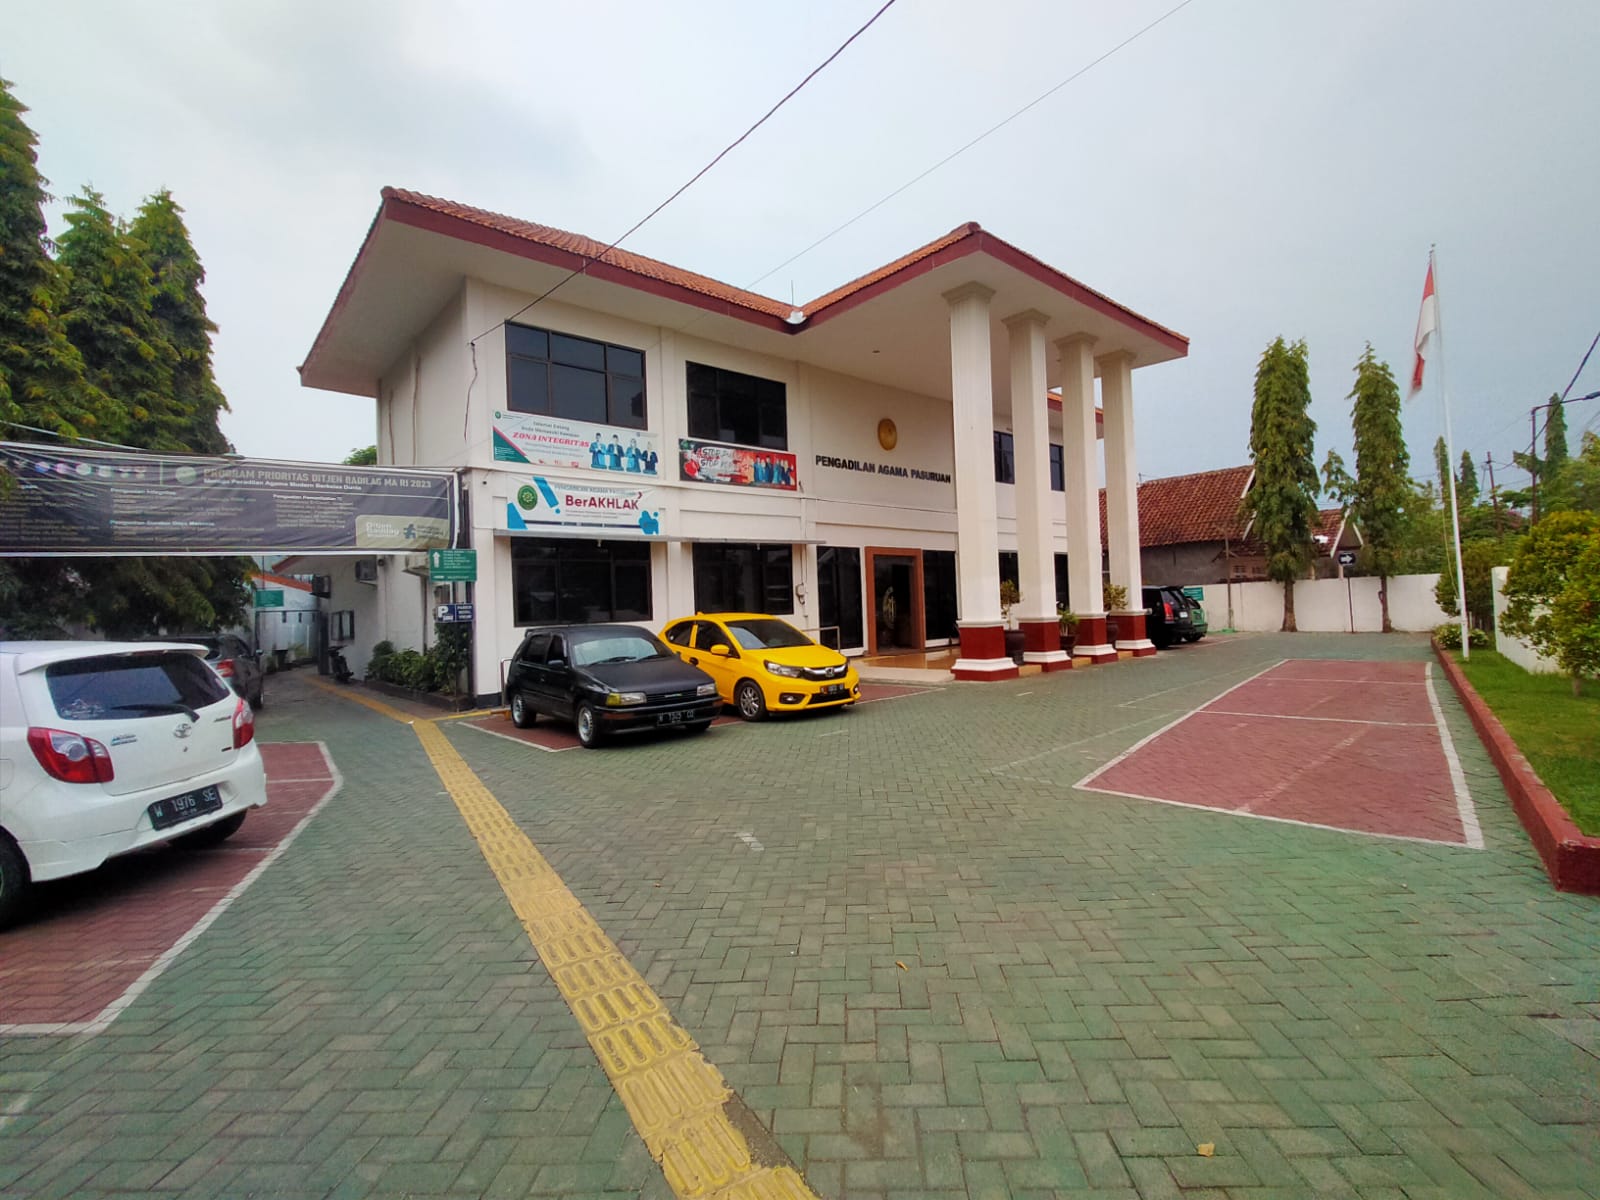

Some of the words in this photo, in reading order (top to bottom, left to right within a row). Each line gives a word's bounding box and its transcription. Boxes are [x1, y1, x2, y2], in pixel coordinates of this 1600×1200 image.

[512, 432, 536, 441] ZONA
[538, 434, 590, 448] INTEGRITAS
[203, 468, 255, 479] PROGRAM
[258, 470, 309, 481] PRIORITAS
[311, 473, 343, 483] DITJEN
[345, 475, 382, 486] BADILAG
[384, 478, 398, 487] MA
[400, 479, 409, 488] RI
[410, 480, 432, 488] 2023
[815, 454, 876, 474] PENGADILAN
[878, 464, 909, 478] AGAMA
[910, 469, 951, 484] PASURUAN
[565, 494, 639, 510] BerAKHLAK
[152, 804, 164, 818] W
[171, 794, 196, 812] 1976
[202, 787, 216, 802] SE
